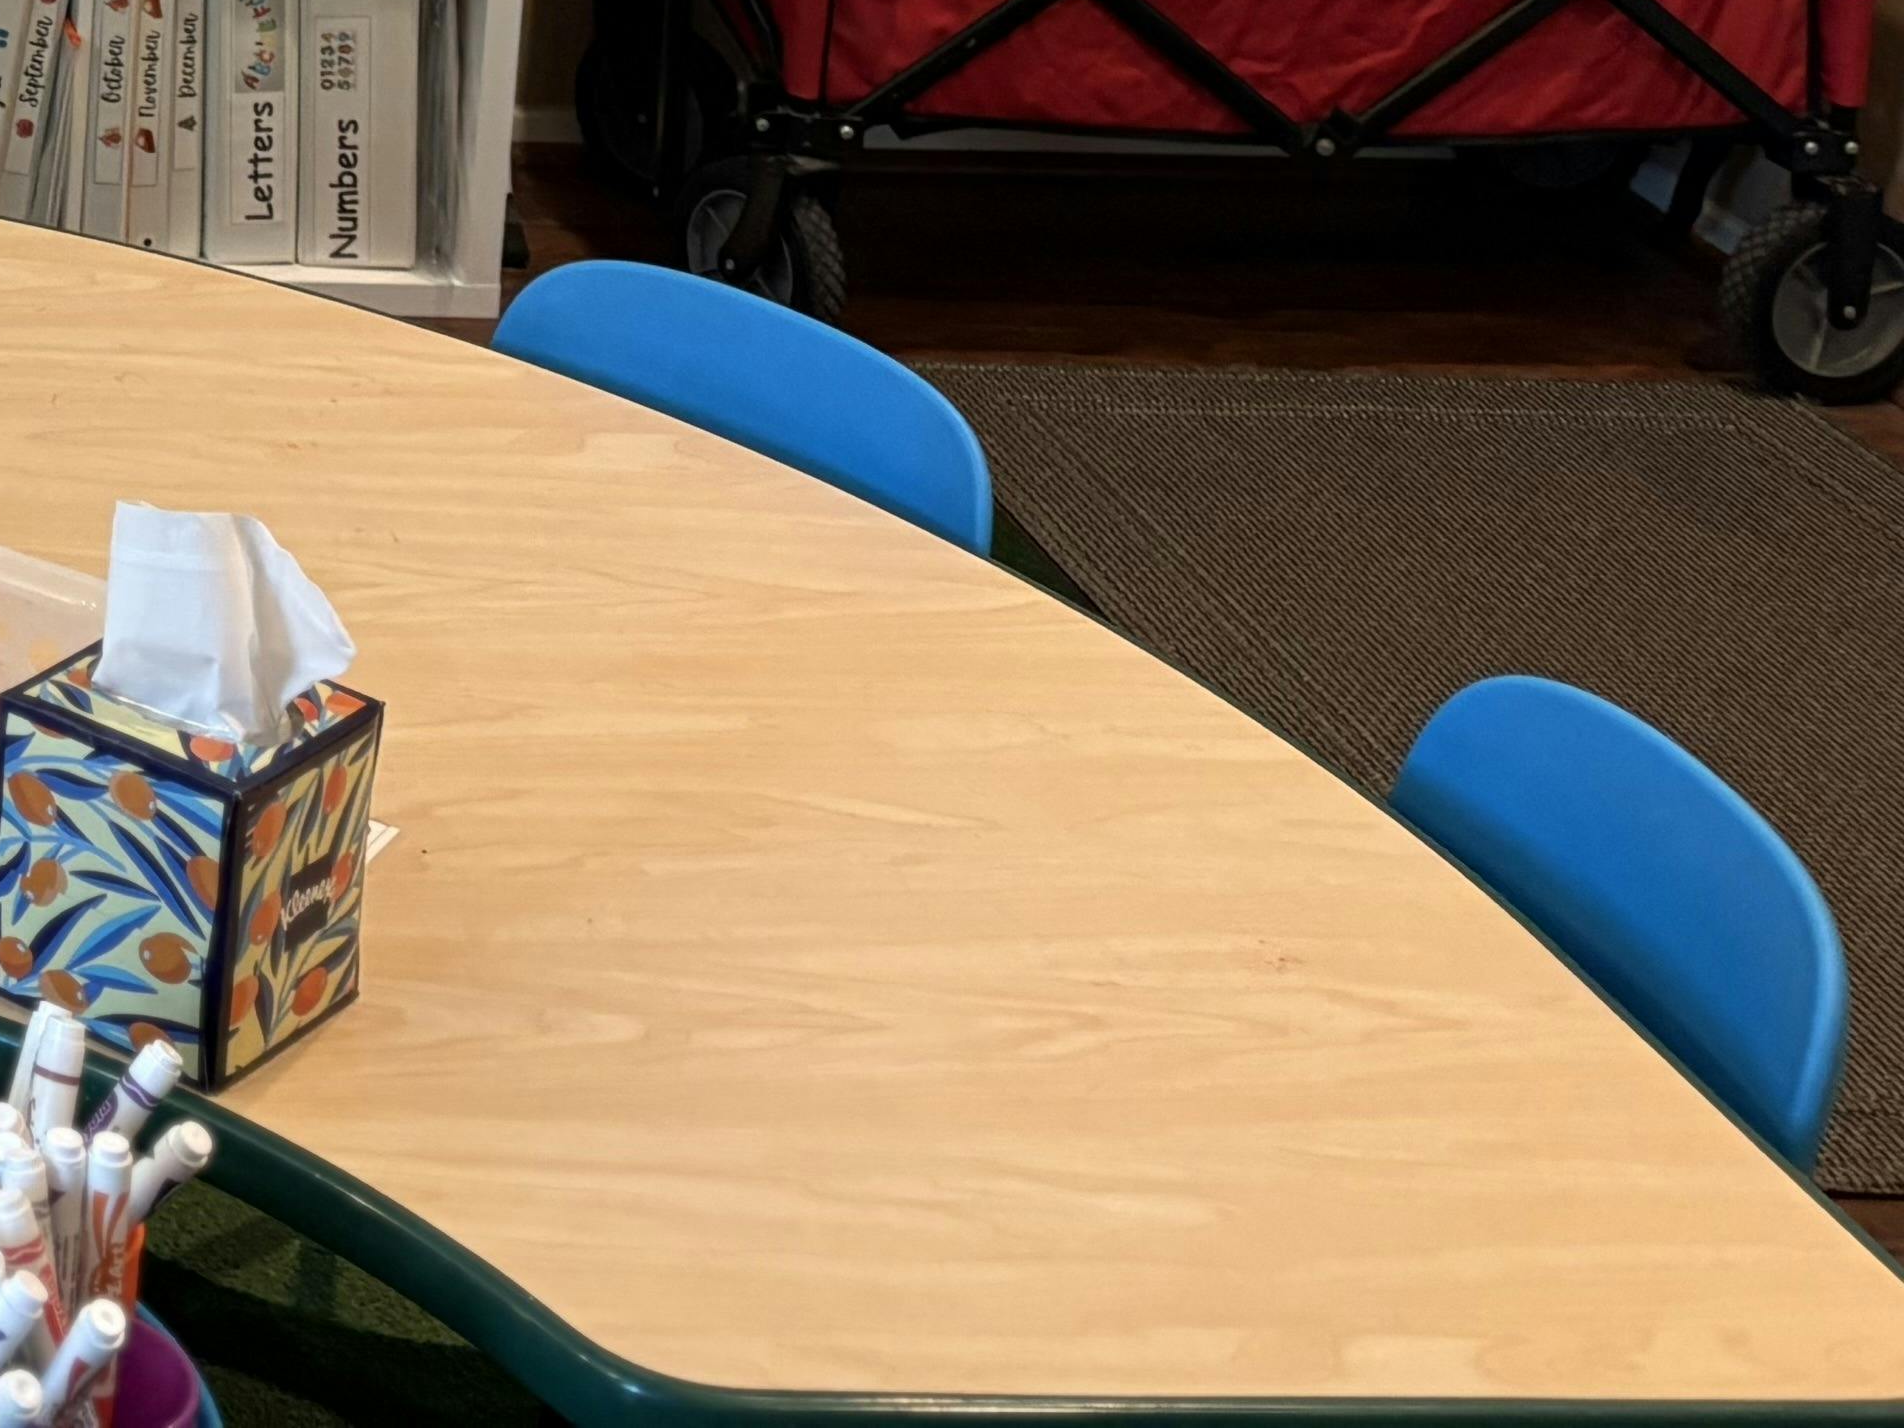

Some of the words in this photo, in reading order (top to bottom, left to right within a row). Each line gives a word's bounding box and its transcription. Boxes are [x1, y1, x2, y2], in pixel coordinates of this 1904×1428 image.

[18, 15, 54, 108] September
[101, 34, 127, 105] October
[137, 29, 163, 120] November
[177, 12, 200, 100] December
[244, 99, 275, 223] Letters
[329, 117, 360, 259] Numbers
